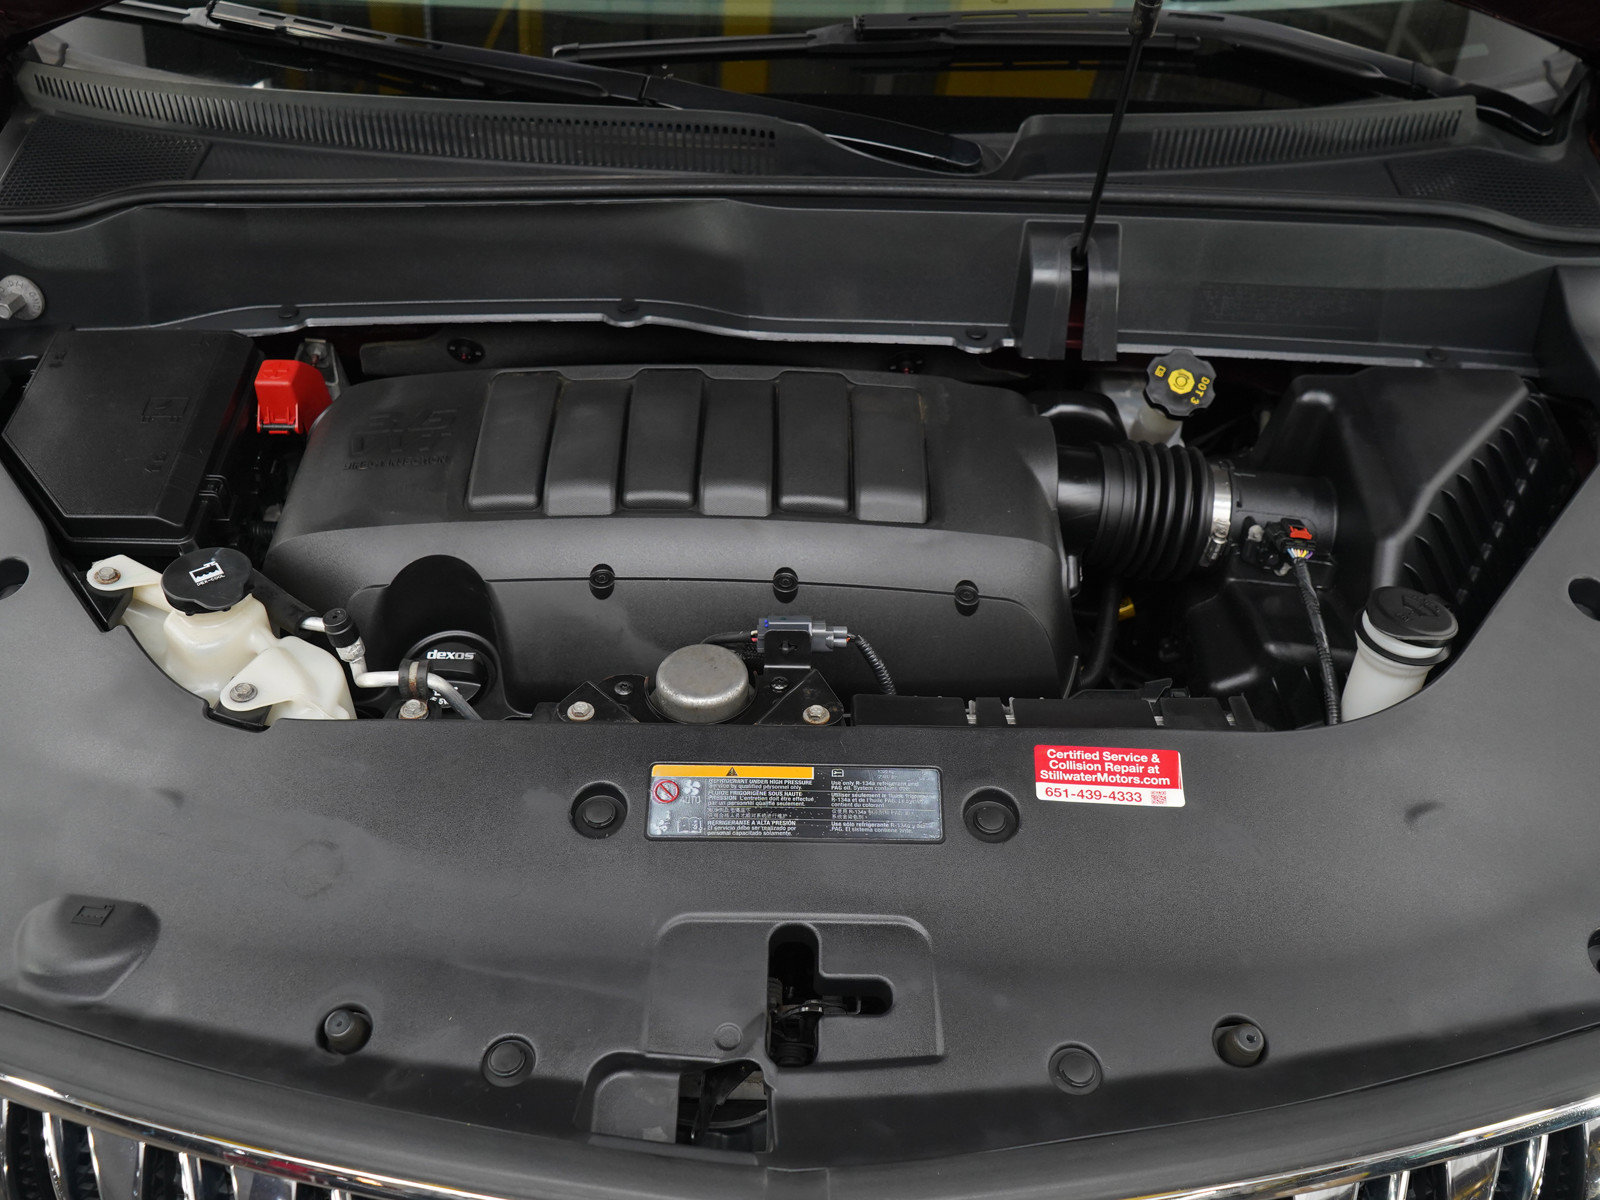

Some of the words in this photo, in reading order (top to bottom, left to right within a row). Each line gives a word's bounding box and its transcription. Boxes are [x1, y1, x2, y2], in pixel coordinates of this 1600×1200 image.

[1195, 376, 1210, 397] DOT
[1190, 396, 1200, 405] 3
[426, 649, 476, 660] dexos
[1046, 748, 1100, 761] Certified
[1102, 751, 1148, 763] Service
[1151, 753, 1161, 763] &
[1049, 759, 1102, 772] Collision
[1104, 762, 1145, 775] Repair
[1147, 764, 1160, 774] at
[1040, 769, 1171, 786] StillwaterMotors.com
[1045, 786, 1143, 803] 651-439-4333
